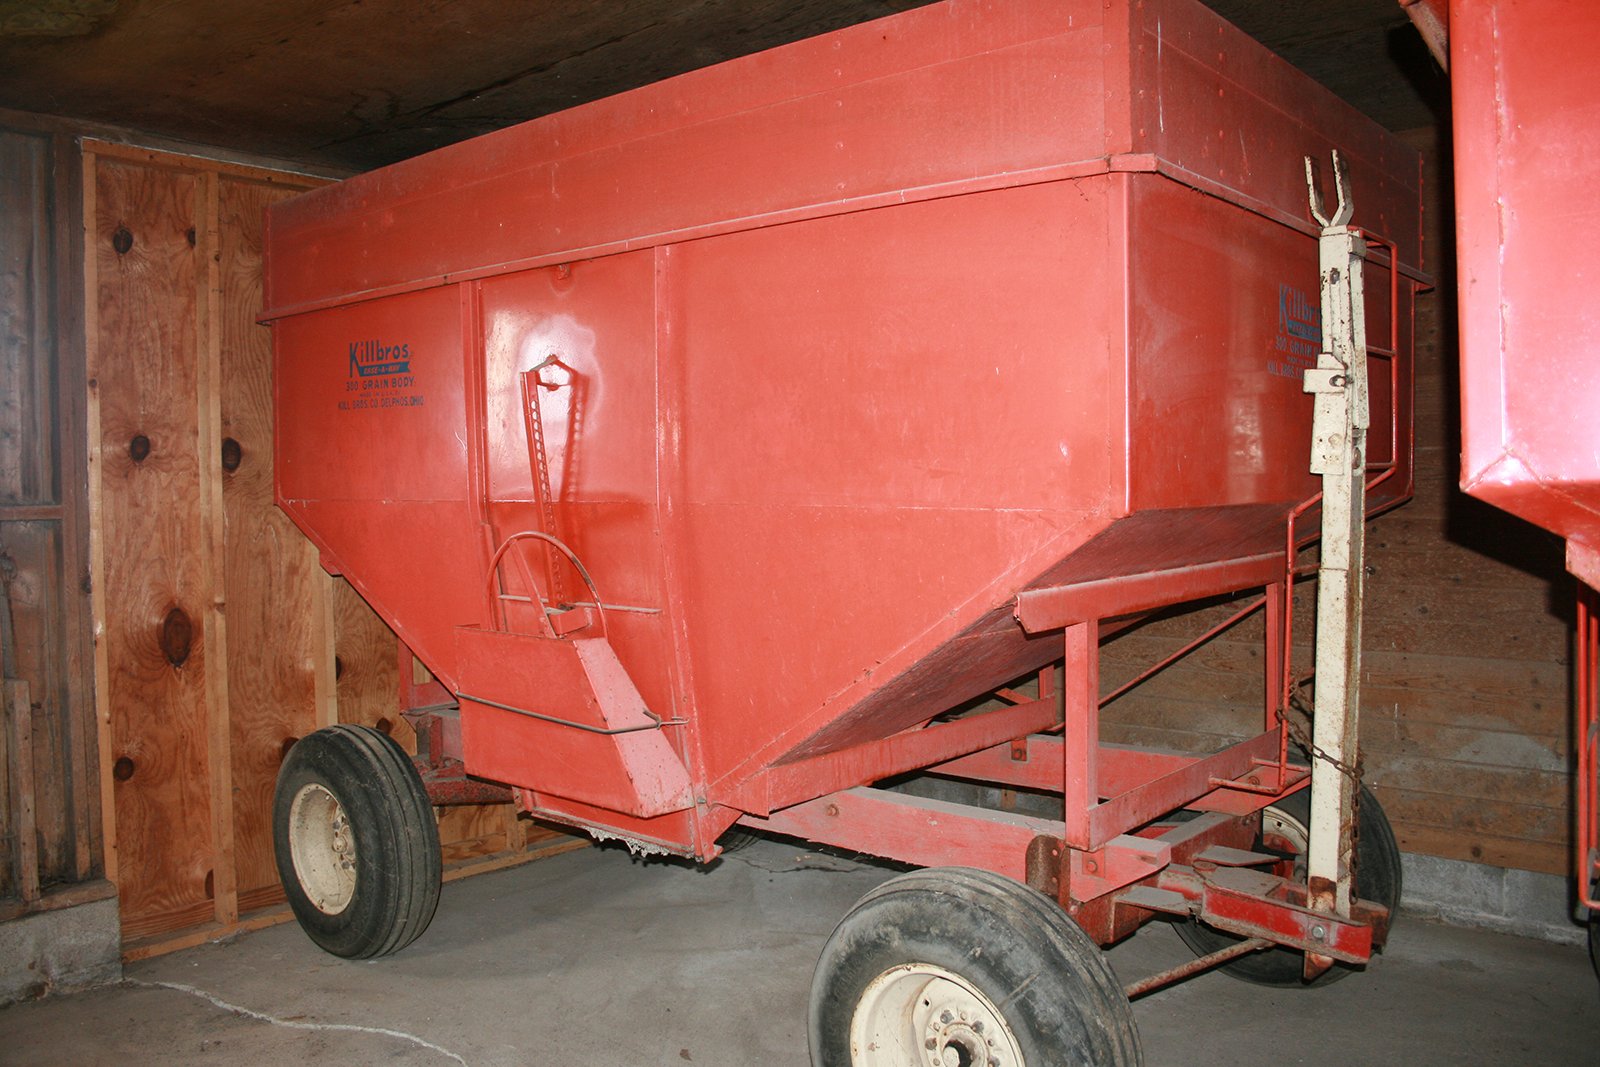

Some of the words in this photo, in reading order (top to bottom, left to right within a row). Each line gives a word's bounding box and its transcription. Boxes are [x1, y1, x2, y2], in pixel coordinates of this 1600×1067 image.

[1279, 282, 1322, 333] Killbro
[349, 340, 410, 378] Killbros
[1290, 339, 1312, 357] GRAIN
[362, 378, 389, 391] GRAIN
[392, 376, 415, 388] BODY
